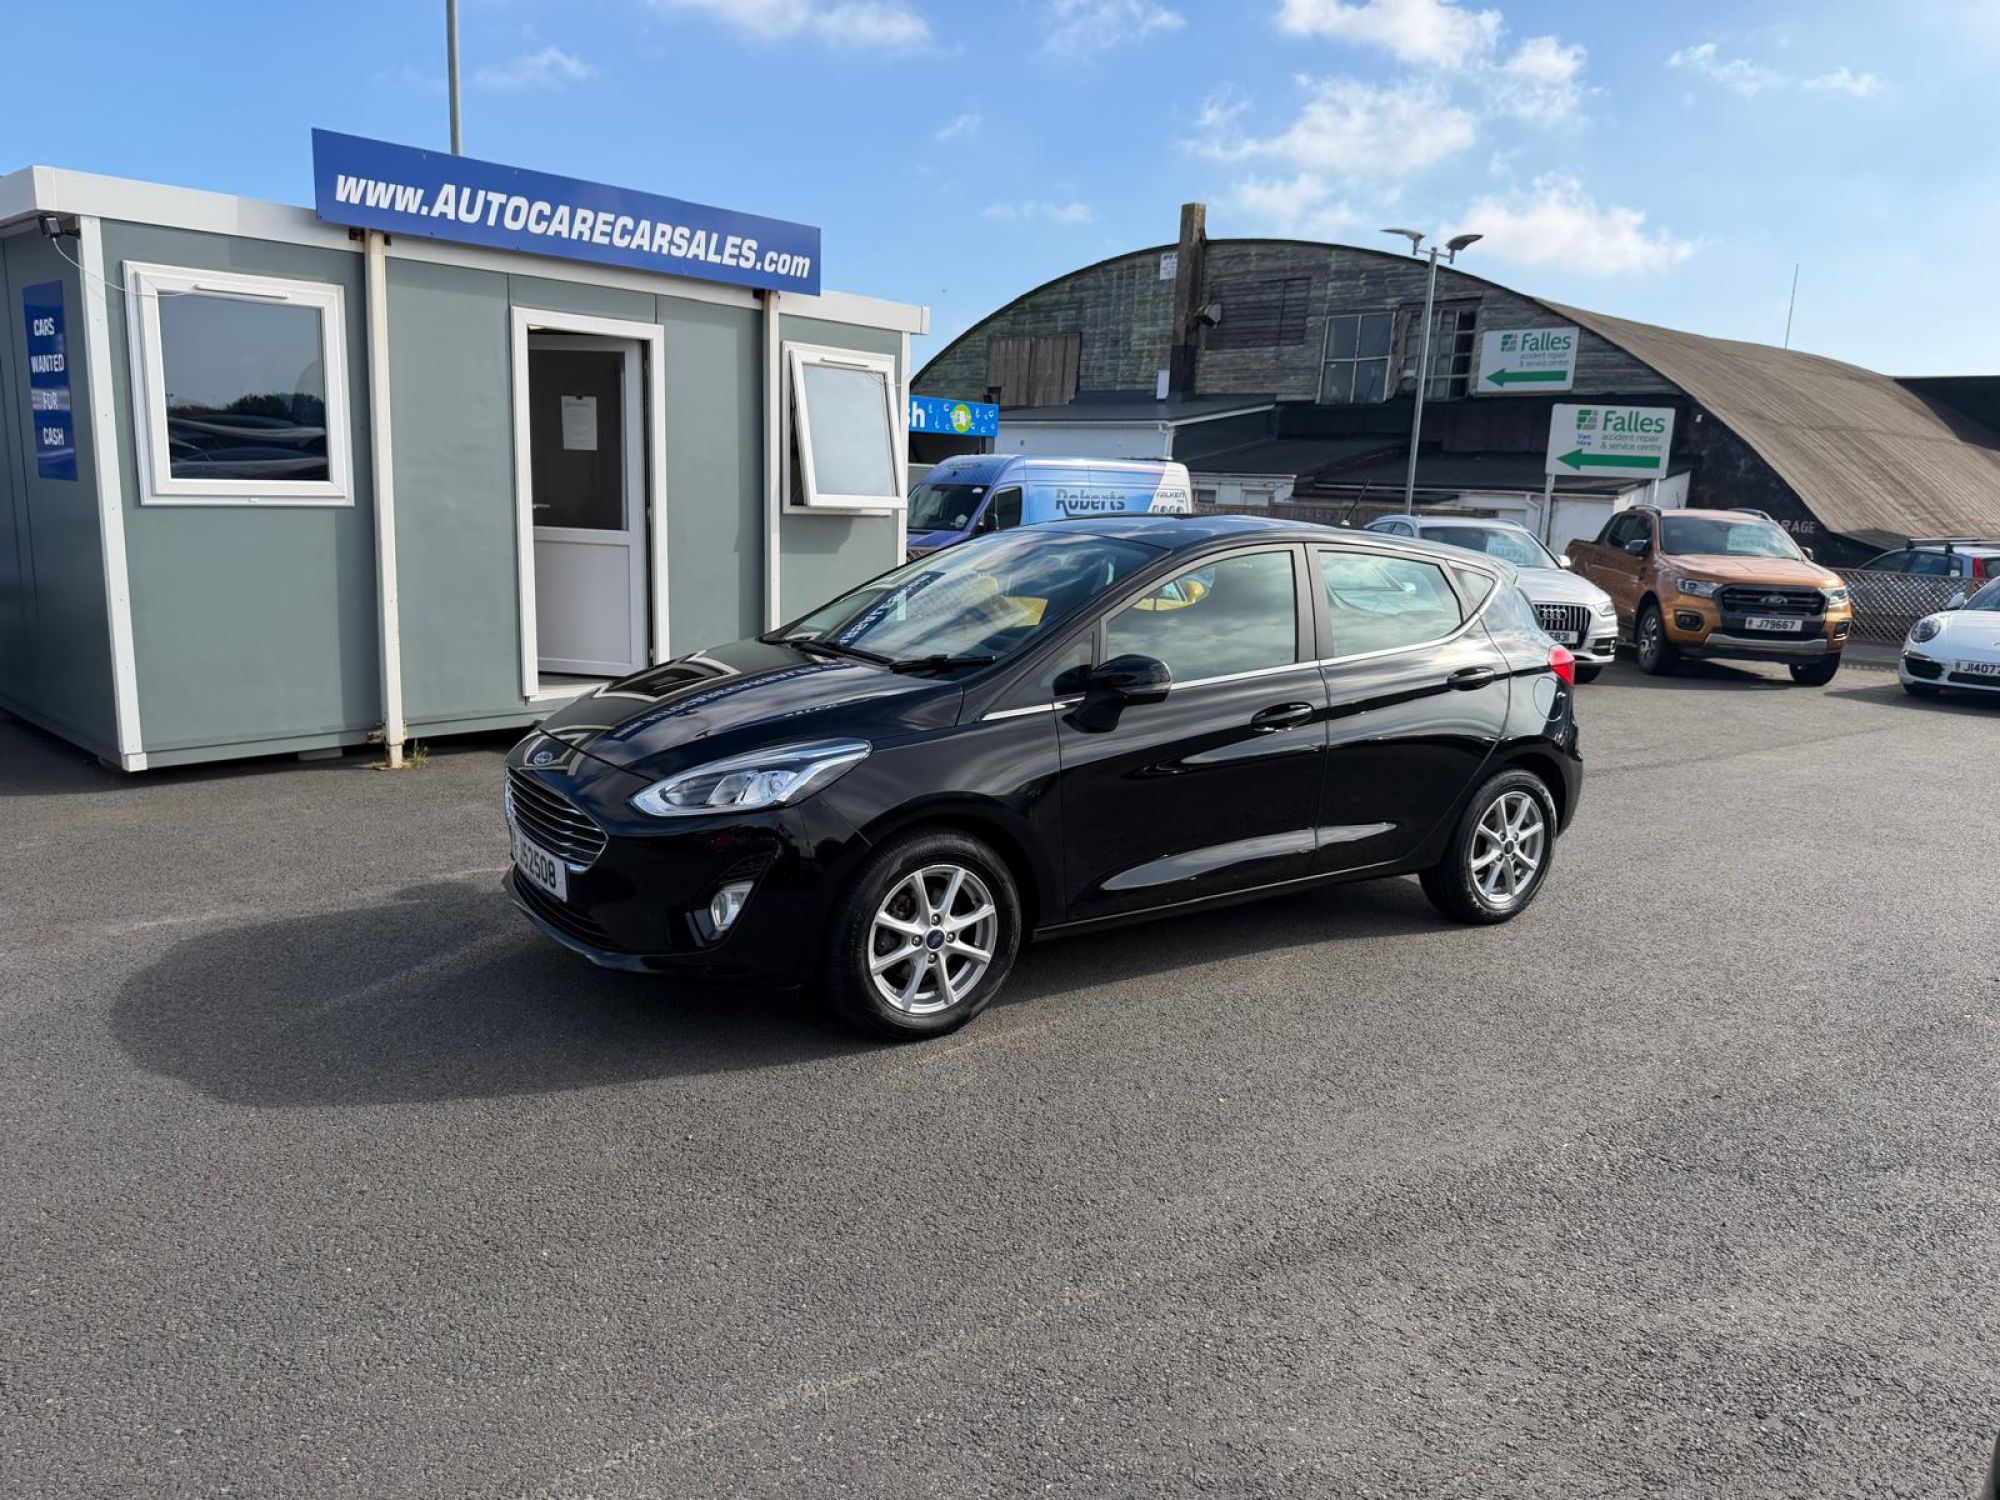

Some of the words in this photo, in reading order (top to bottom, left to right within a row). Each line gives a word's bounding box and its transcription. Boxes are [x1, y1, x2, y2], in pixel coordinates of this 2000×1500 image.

[33, 318, 55, 337] CARS
[1520, 332, 1572, 351] Falles
[31, 354, 65, 373] WANTED
[43, 391, 58, 410] FOR
[1603, 410, 1666, 433] Falles
[43, 427, 65, 446] CASH
[1601, 432, 1634, 442] accident
[1056, 489, 1126, 512] Roberts
[1756, 619, 1796, 630] J79667
